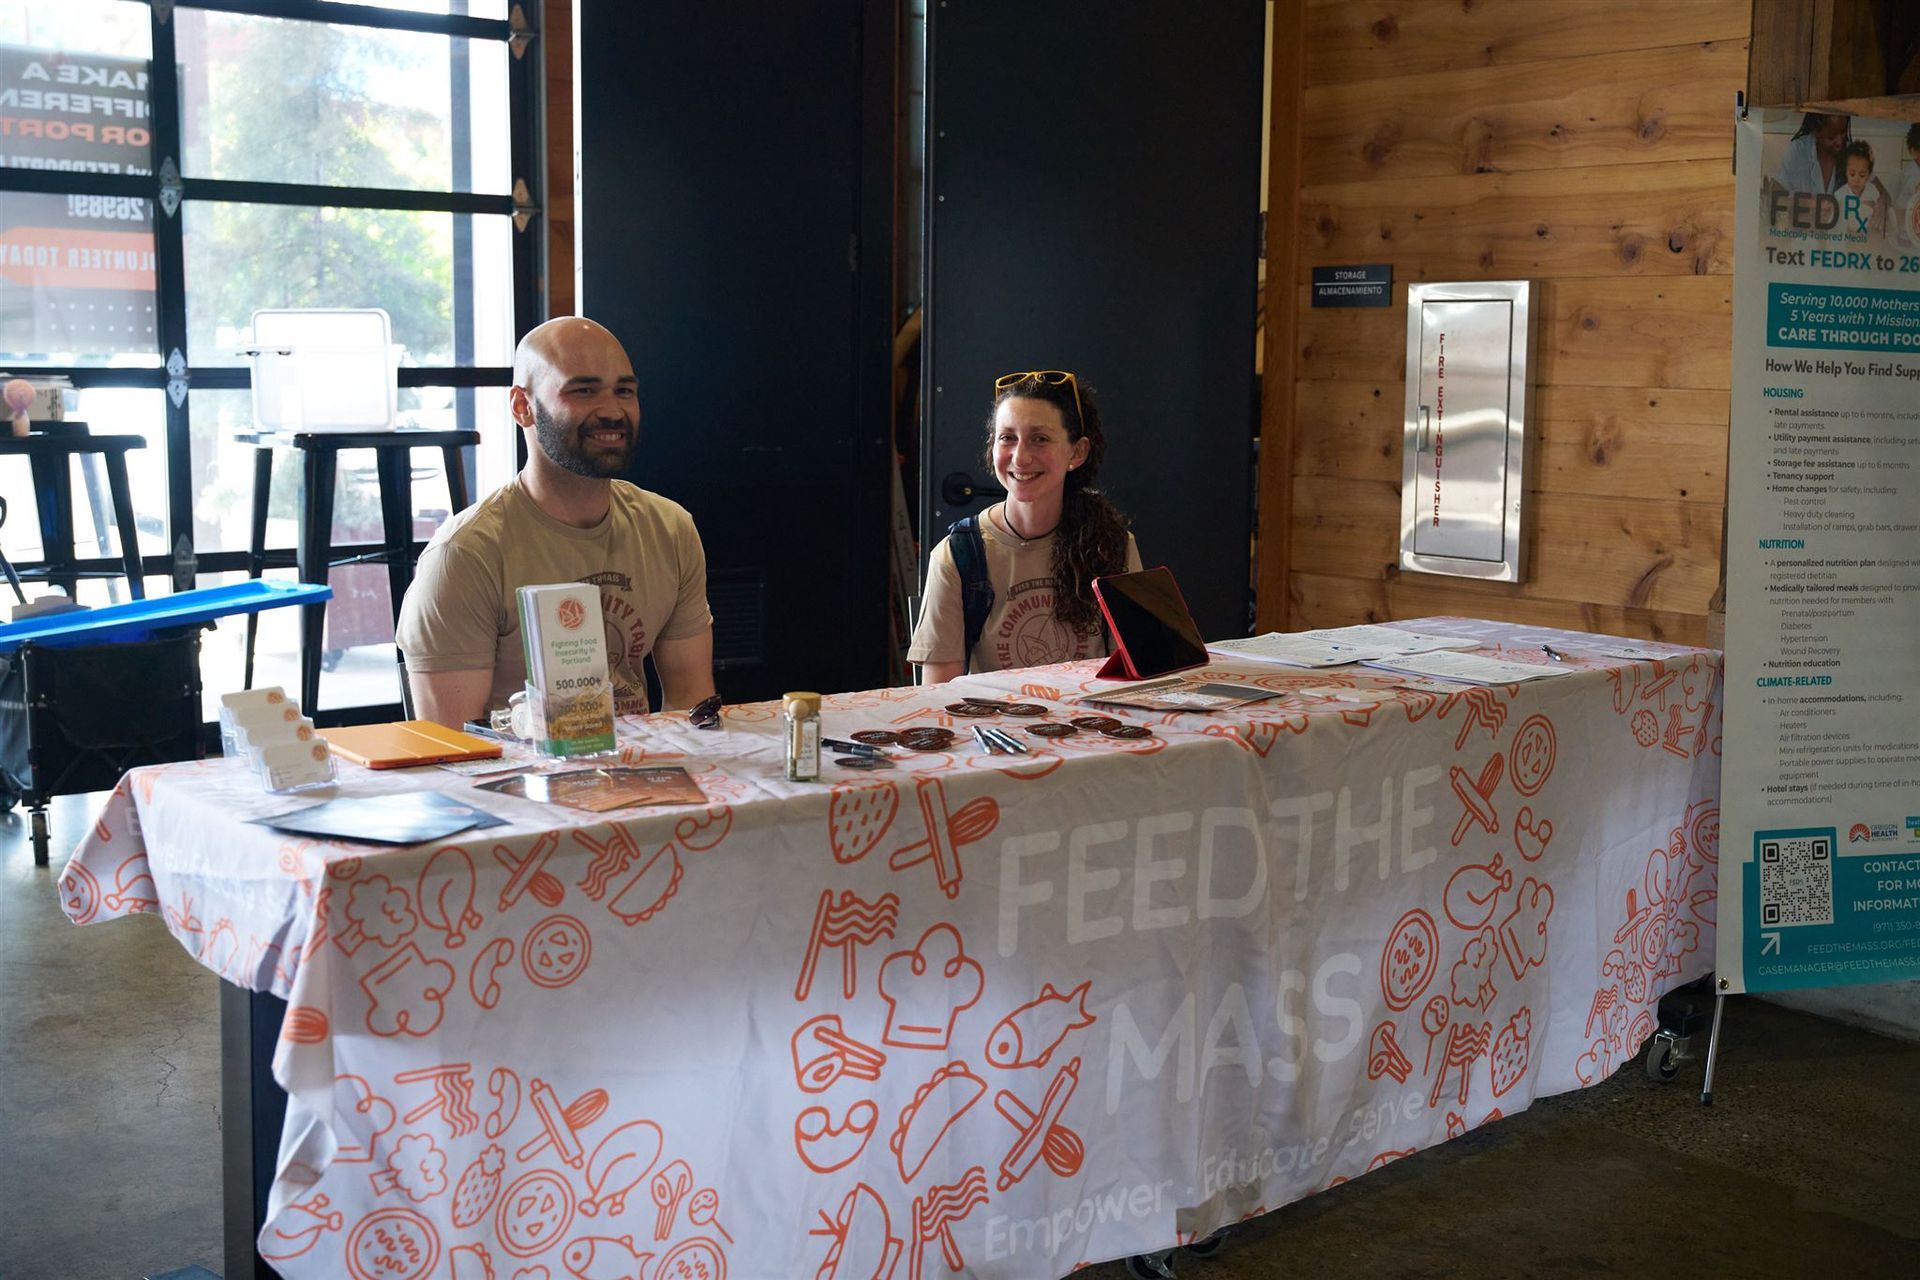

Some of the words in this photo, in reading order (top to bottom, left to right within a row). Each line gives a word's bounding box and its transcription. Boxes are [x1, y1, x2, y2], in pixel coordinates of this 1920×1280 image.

[1769, 228, 1807, 240] Medically
[1810, 230, 1843, 241] Tailored
[1844, 234, 1867, 242] Meals
[1766, 247, 1804, 266] Text
[1810, 249, 1872, 269] FEDRX
[1876, 255, 1894, 270] to
[1334, 271, 1366, 280] STORAGE
[1319, 286, 1383, 296] ALMACENAMIENTO
[1780, 292, 1826, 309] Serving
[1830, 295, 1868, 309] 10,000
[1871, 298, 1920, 311] Mothers
[1790, 310, 1798, 322] 5
[1801, 310, 1835, 323] Years
[1838, 312, 1865, 324] with
[1868, 313, 1873, 324] 1
[1876, 315, 1920, 327] Mission
[1779, 327, 1816, 341] CARE
[1820, 330, 1888, 344] THROUGH
[1766, 358, 1792, 372] How
[1794, 360, 1813, 373] We
[1816, 361, 1842, 378] Help
[1844, 362, 1865, 375] You
[1869, 363, 1892, 376] Find
[1763, 388, 1804, 398] HOUSING
[1775, 408, 1799, 416] Rental
[1774, 434, 1796, 443] Utility
[1798, 435, 1830, 443] payment
[1873, 436, 1906, 445] including
[1433, 386, 1443, 528] EXTINGUISHER
[1773, 459, 1801, 469] Storage
[1818, 460, 1855, 468] assistance
[1773, 472, 1803, 481] Tenancy
[1805, 473, 1834, 481] support
[1796, 486, 1827, 494] changes
[1784, 497, 1799, 505] Pest
[1784, 510, 1805, 519] Heavy
[1807, 511, 1823, 519] duty
[1825, 511, 1855, 519] cleaning
[1784, 523, 1822, 531] Installation
[1858, 524, 1874, 532] grab
[1759, 539, 1804, 549] NUTRITION
[1777, 559, 1824, 568] personalized
[1826, 559, 1858, 567] nutrition
[1860, 559, 1876, 568] plan
[1877, 559, 1909, 568] designed
[1770, 572, 1805, 581] registered
[1860, 584, 1892, 593] designed
[1831, 596, 1840, 604] for
[1842, 596, 1876, 604] members
[1782, 610, 1854, 618] Prenatal/postpartum
[1781, 635, 1828, 644] Hypertension
[551, 641, 579, 650] Fighting
[1808, 647, 1840, 656] Recovery
[561, 656, 591, 665] Portland
[1757, 676, 1832, 687] CLIMATE-RELATED
[1791, 708, 1836, 716] conditioners
[1780, 722, 1807, 730] Heaters
[1796, 746, 1841, 755] refrigeration
[1875, 742, 1919, 750] medications
[1780, 759, 1809, 767] Portable
[1836, 757, 1866, 766] supplies
[1877, 756, 1904, 764] operate
[1779, 772, 1819, 781] equipment
[1767, 785, 1787, 793] Hotel
[1789, 785, 1808, 793] stays
[1818, 782, 1846, 791] needed
[1848, 782, 1873, 790] during
[1874, 780, 1892, 788] time
[1893, 779, 1900, 787] of
[1767, 796, 1832, 806] accommodations)
[996, 805, 1271, 958] FEED
[1271, 764, 1442, 902] THE
[1864, 860, 1920, 873] CONTACT
[1878, 880, 1903, 892] FOR
[1106, 953, 1365, 1116] MASS
[983, 1177, 1174, 1261] Empower
